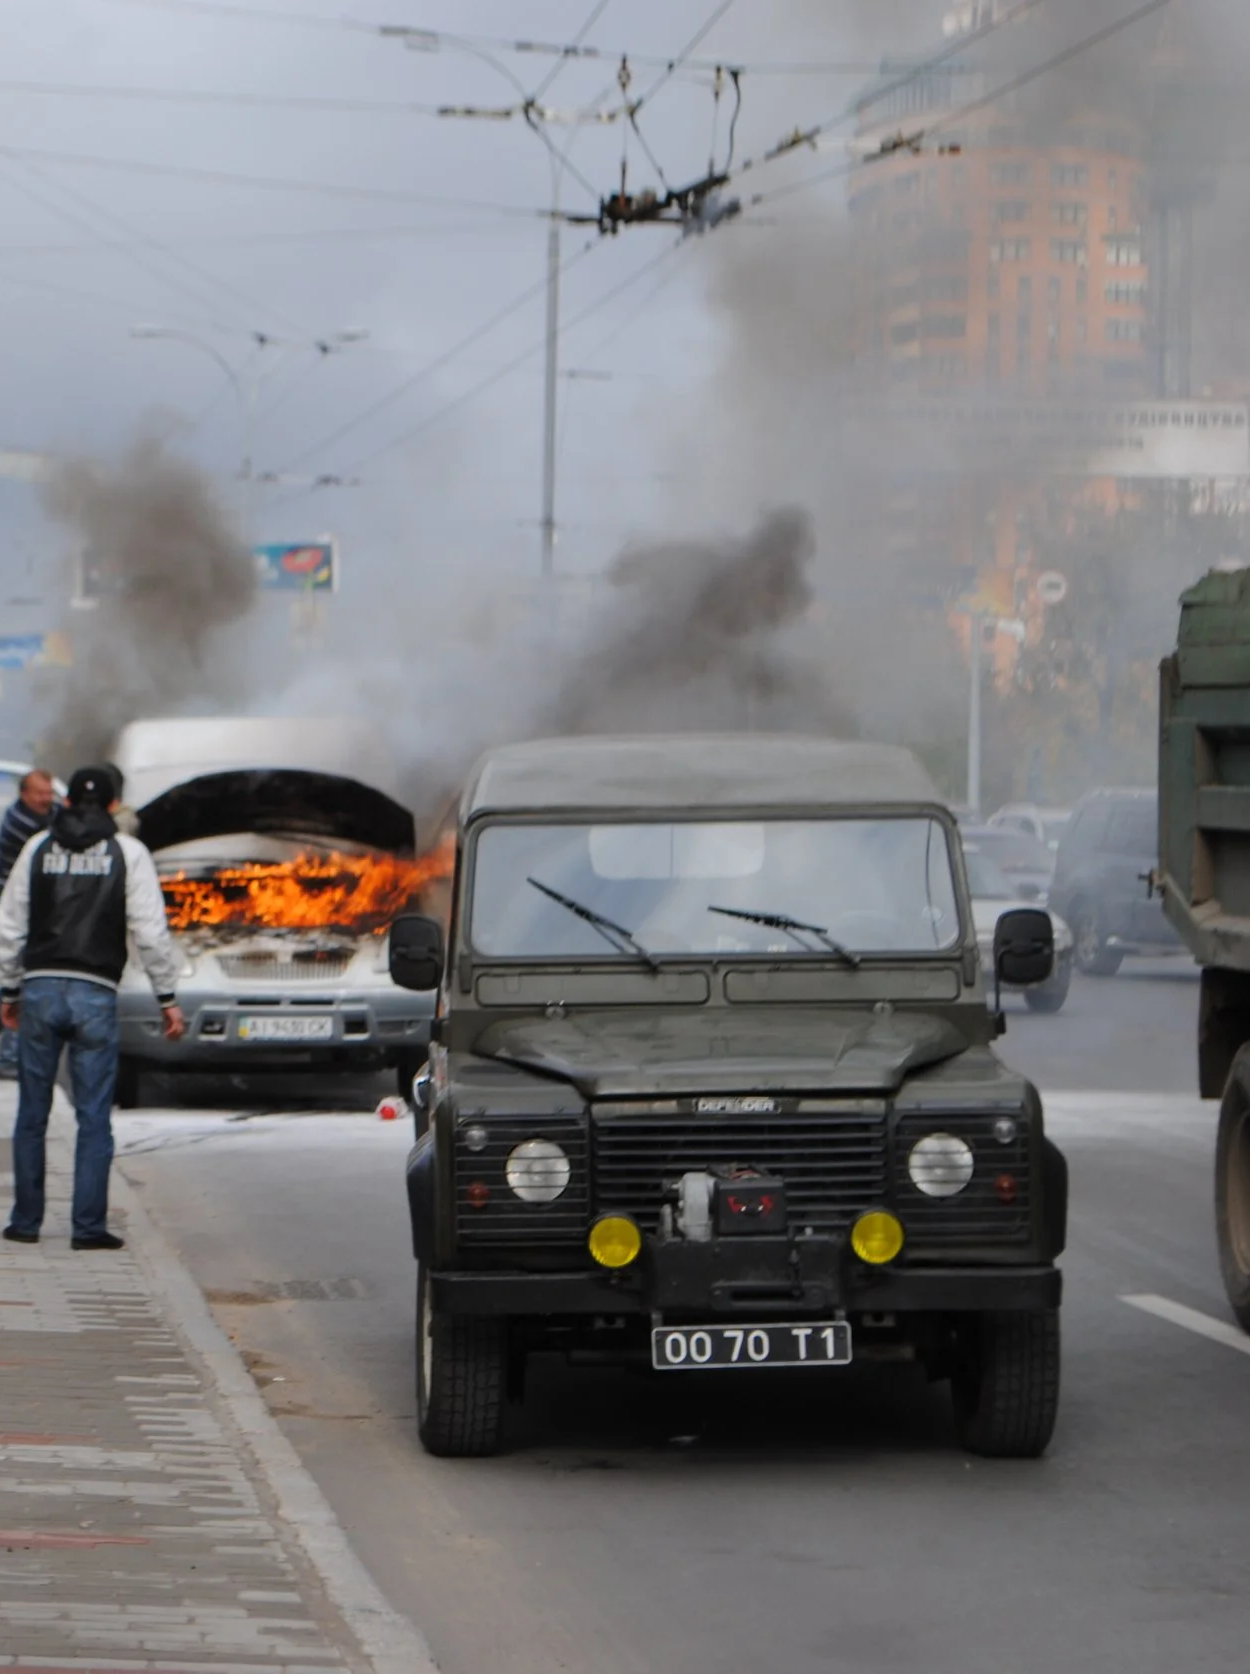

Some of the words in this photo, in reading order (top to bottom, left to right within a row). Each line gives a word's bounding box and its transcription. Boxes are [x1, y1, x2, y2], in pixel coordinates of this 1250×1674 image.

[697, 1096, 775, 1113] DEFENDER
[664, 1331, 713, 1364] 00
[723, 1329, 770, 1362] 70
[790, 1327, 835, 1361] T1
